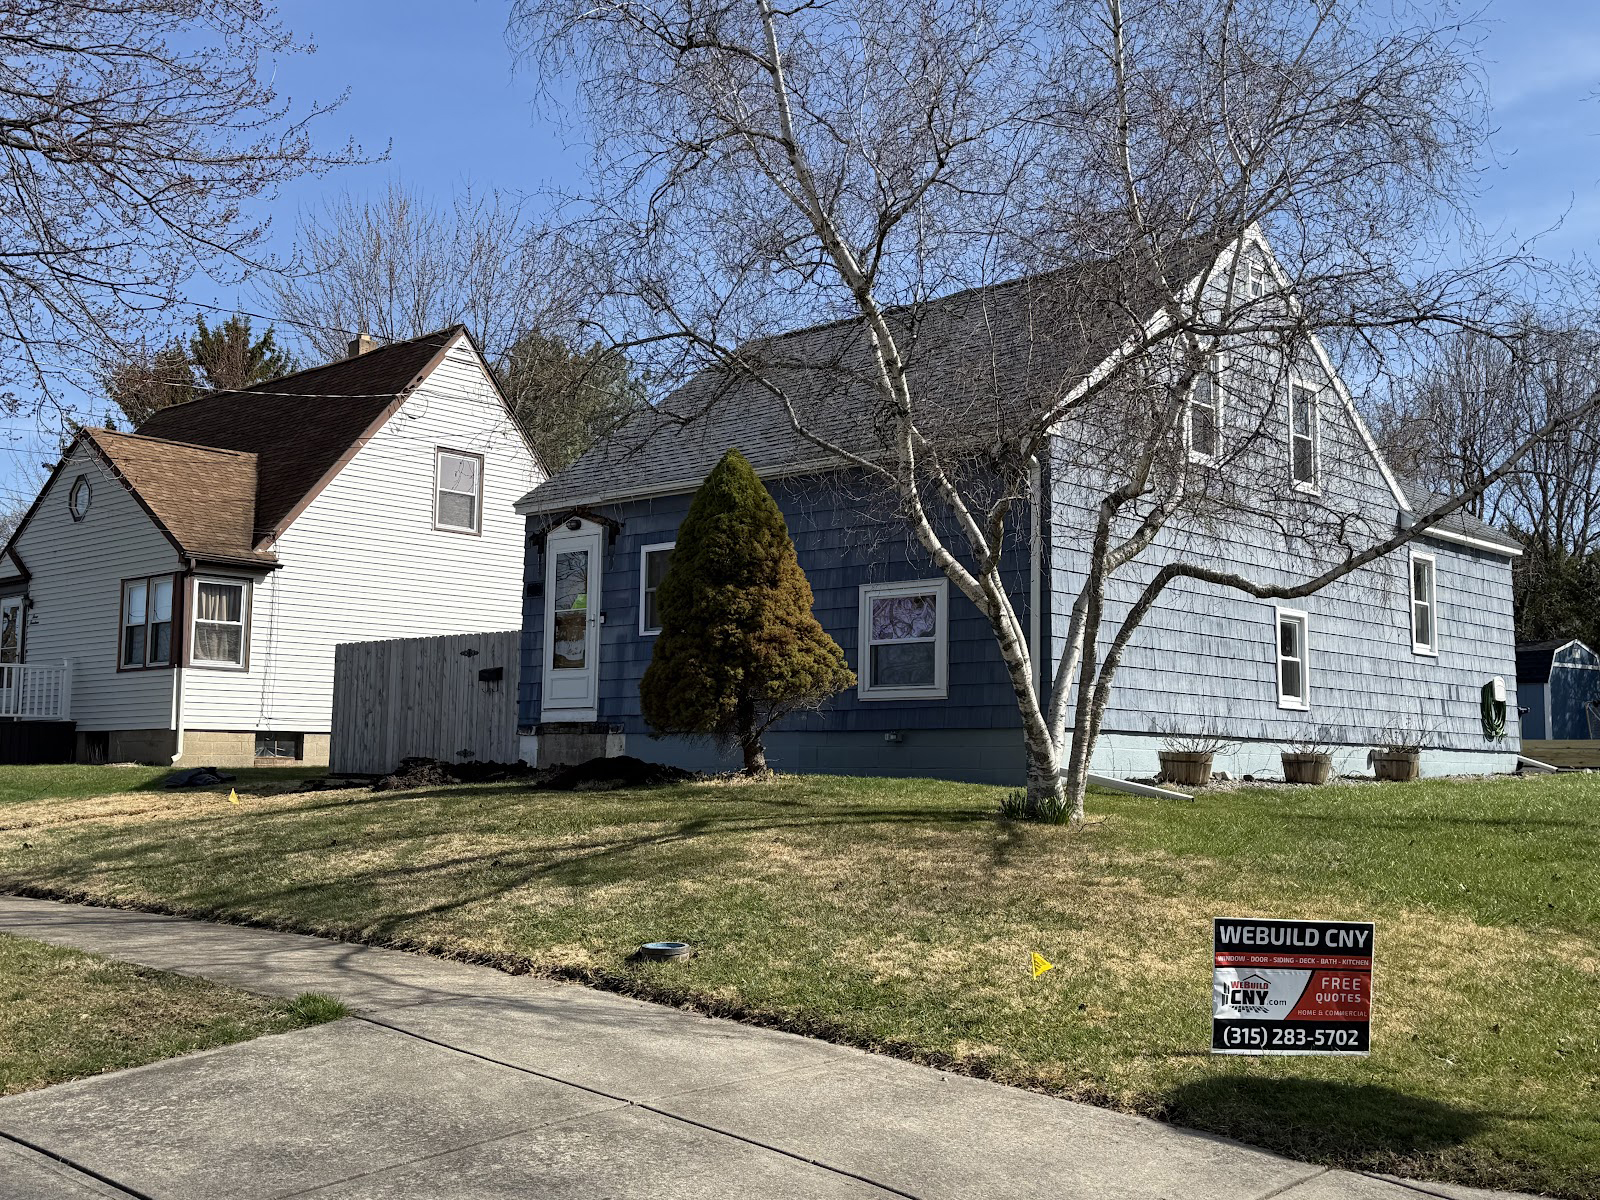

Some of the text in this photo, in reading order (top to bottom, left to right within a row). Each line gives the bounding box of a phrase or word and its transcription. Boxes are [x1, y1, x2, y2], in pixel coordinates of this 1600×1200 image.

[1219, 925, 1370, 948] WEBUILD CNY
[1217, 955, 1246, 963] WINDOW
[1273, 956, 1295, 964] SIDING
[1299, 957, 1316, 965] DECK
[1321, 977, 1362, 991] FREE
[1315, 992, 1361, 1005] QUOTES
[1223, 1025, 1359, 1047] (315) 283-5702
